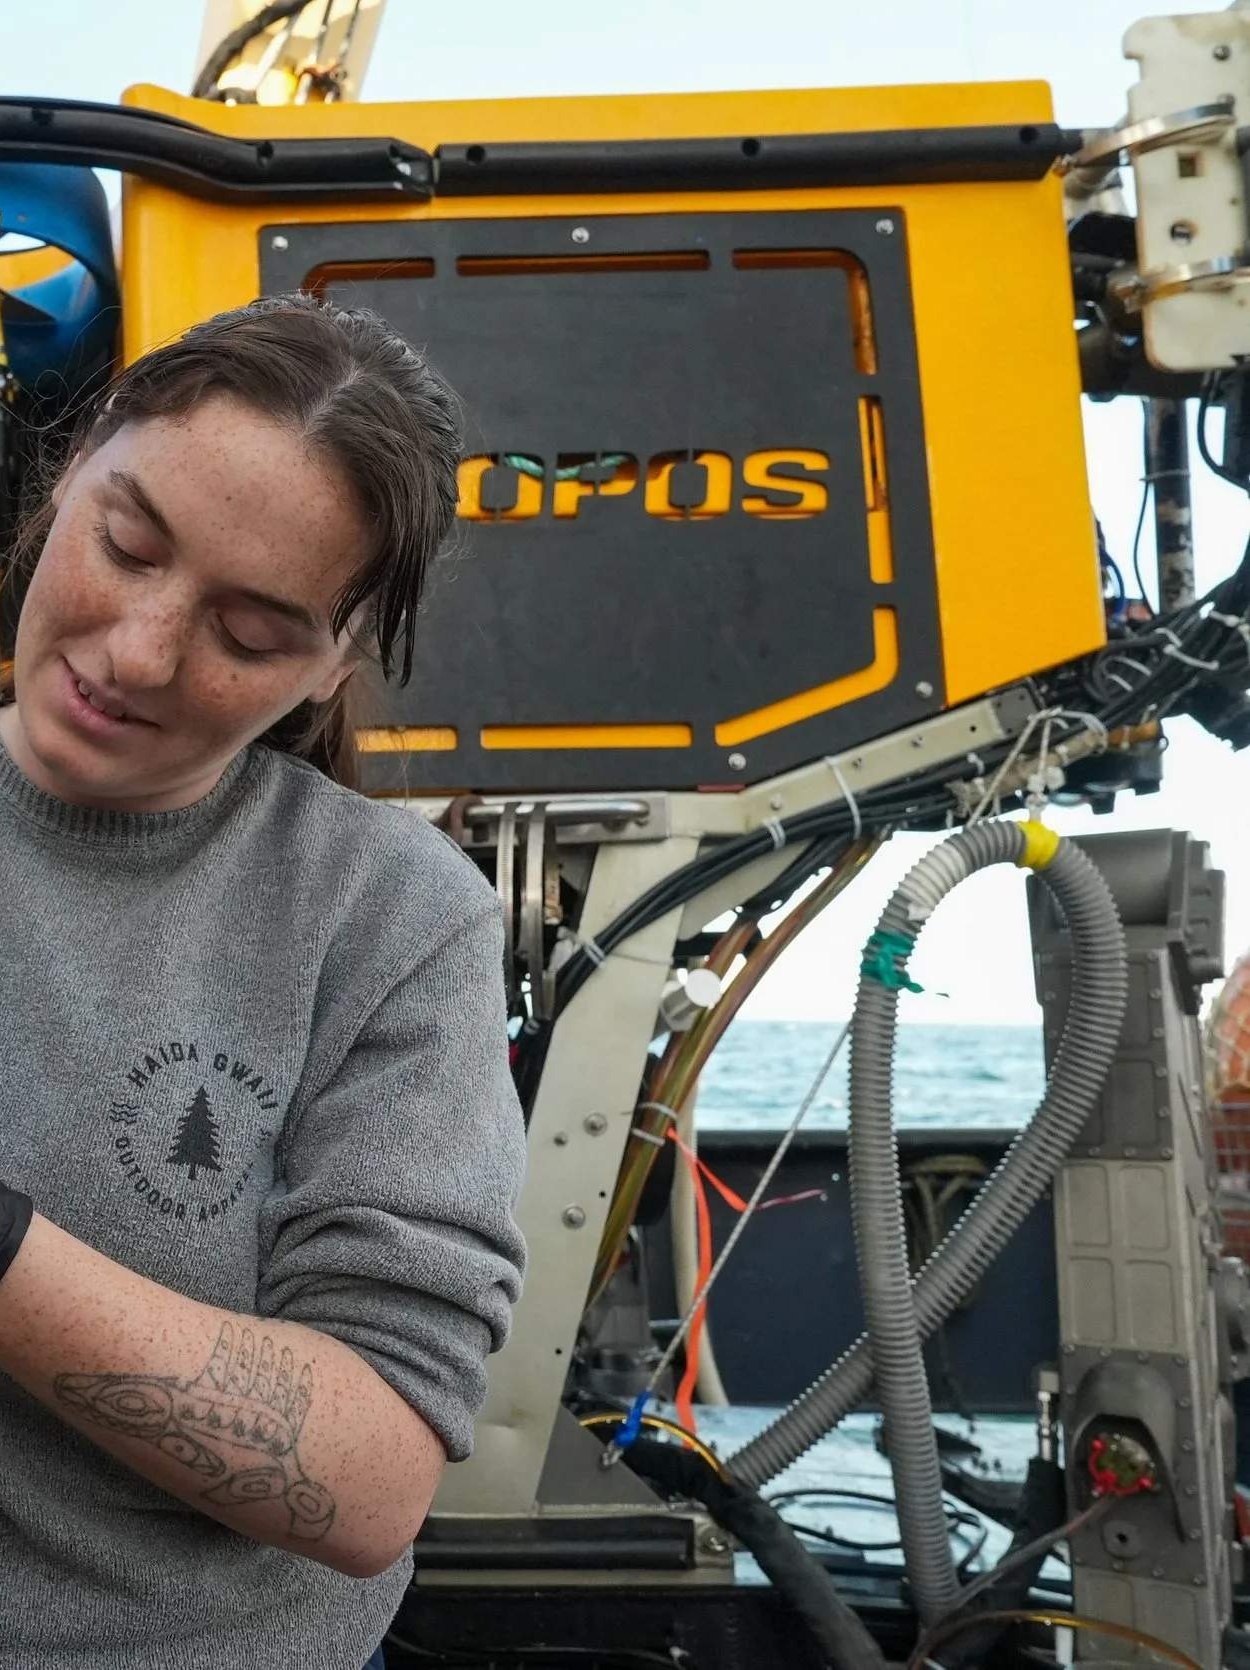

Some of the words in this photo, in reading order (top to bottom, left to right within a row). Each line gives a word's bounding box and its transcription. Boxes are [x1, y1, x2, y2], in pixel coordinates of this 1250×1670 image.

[127, 1042, 199, 1089] HAIDA
[213, 1053, 279, 1110] GWAII
[115, 1136, 185, 1220] OUTDOOR
